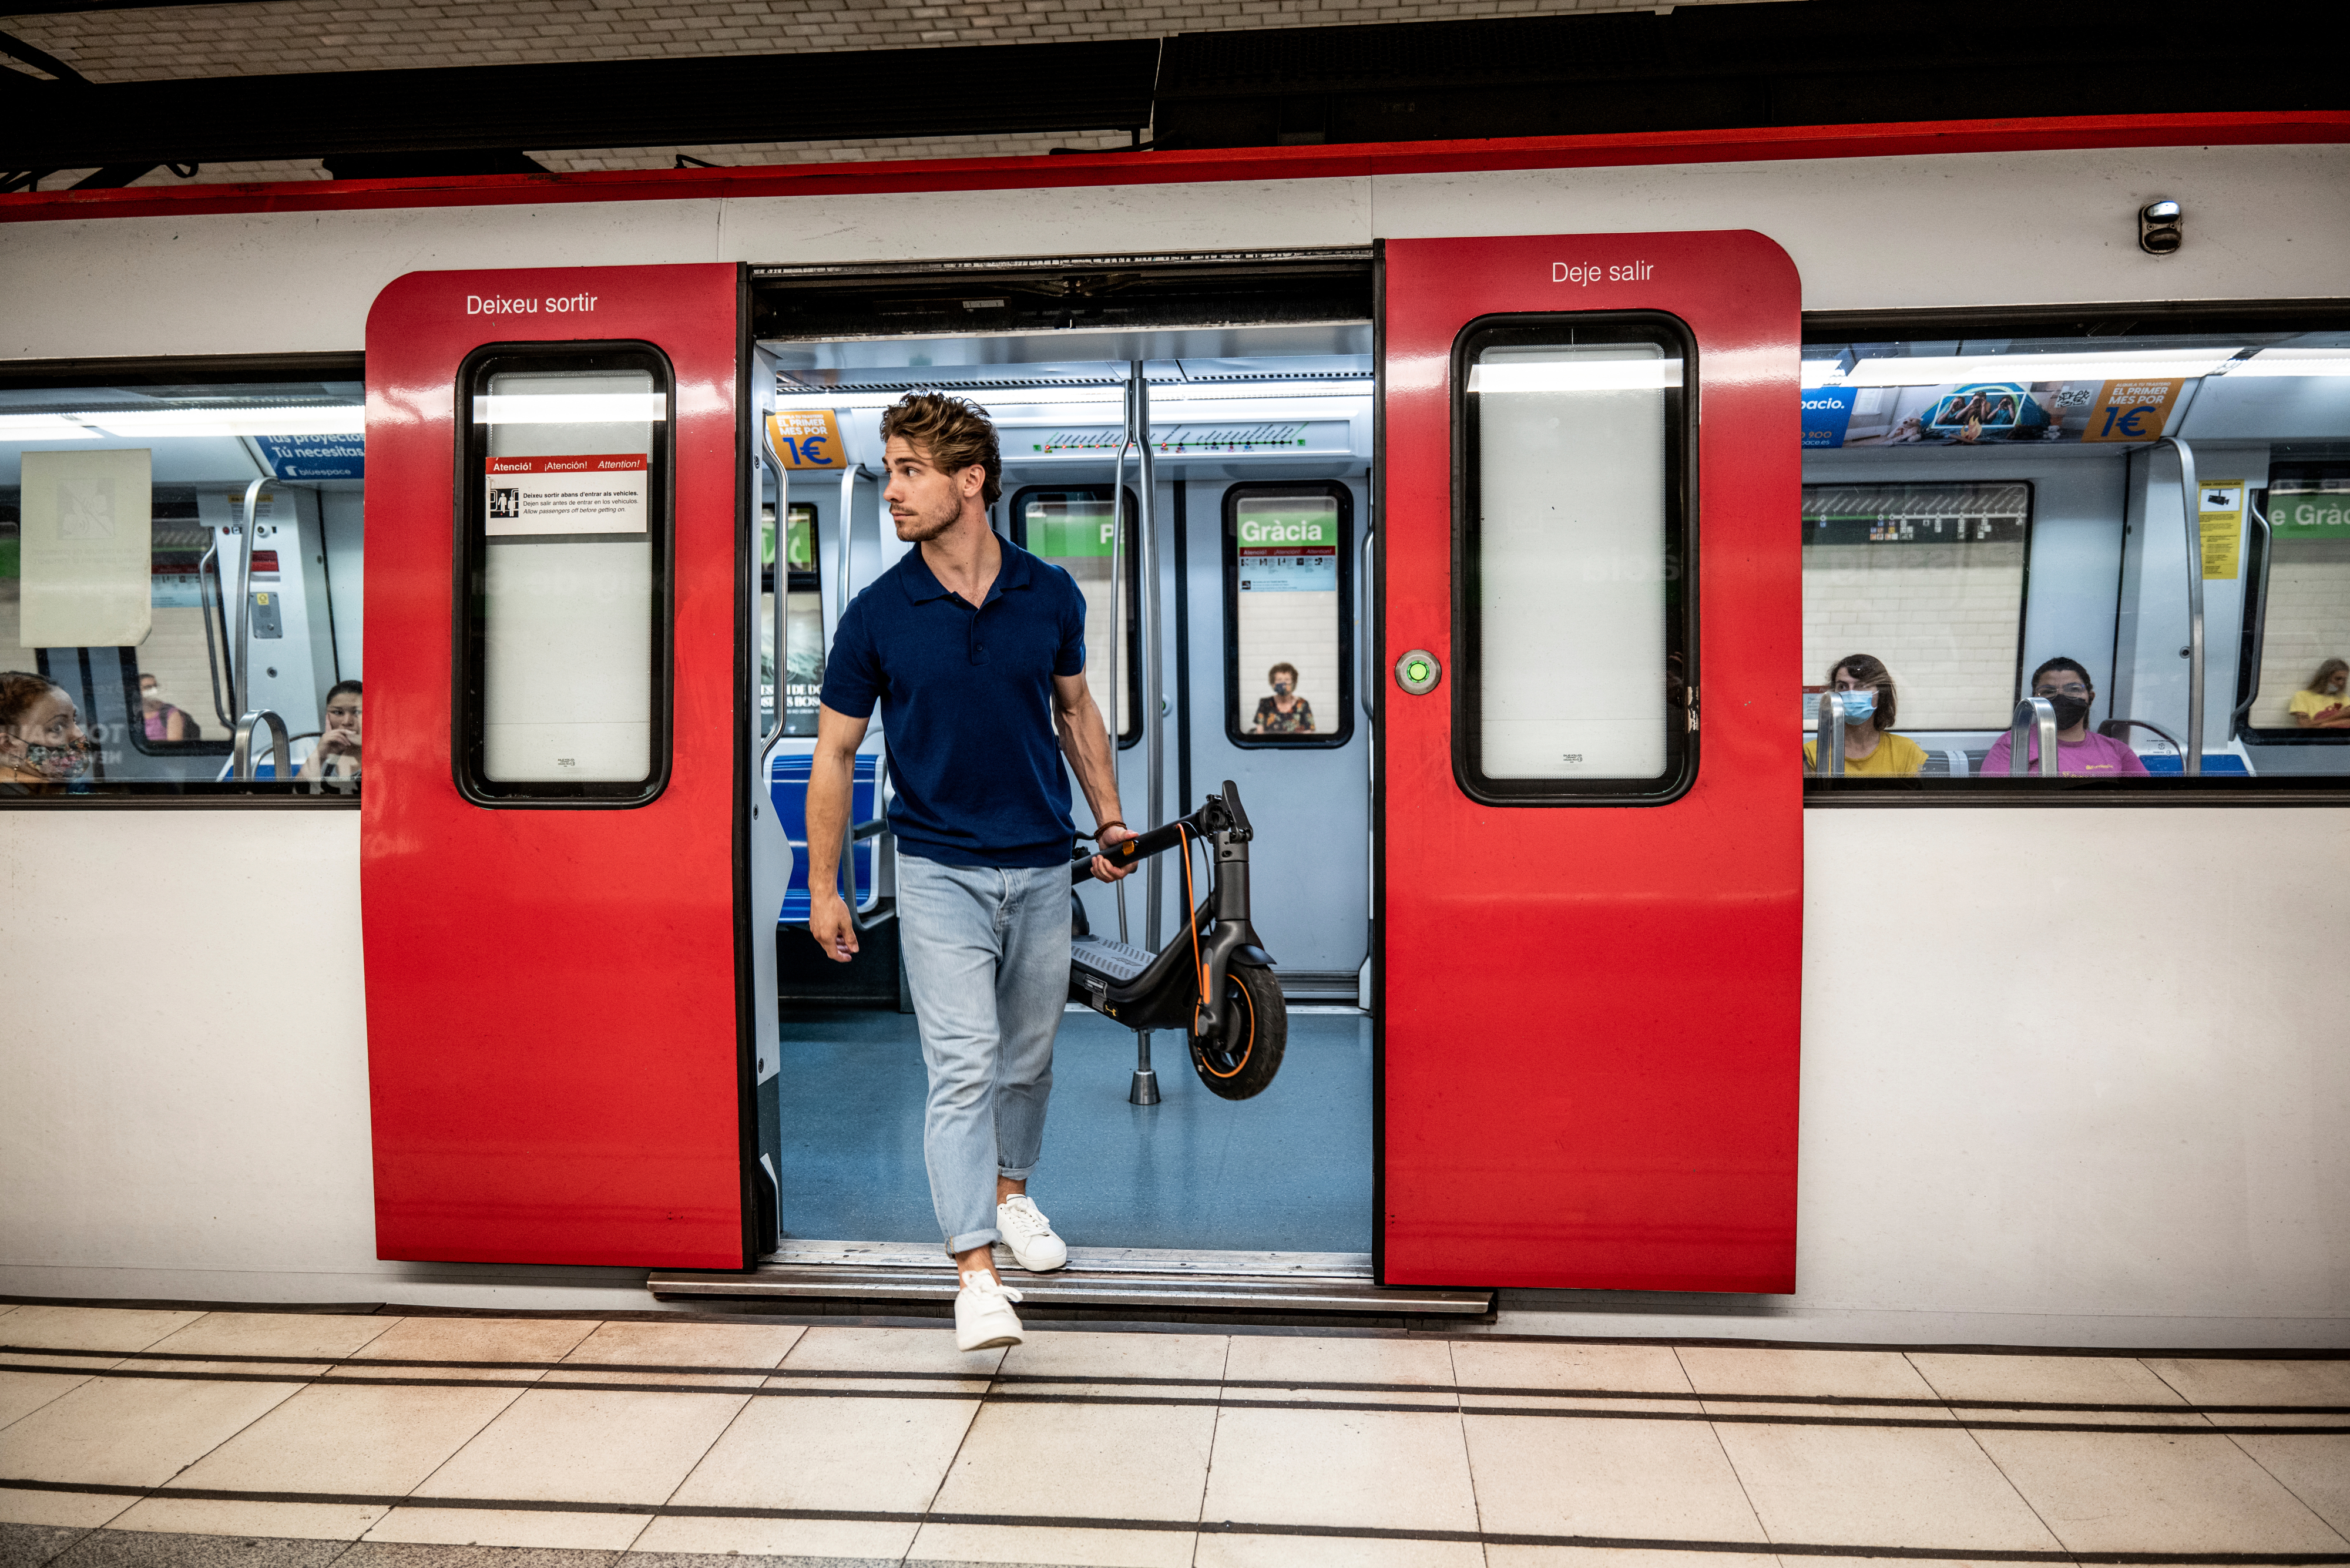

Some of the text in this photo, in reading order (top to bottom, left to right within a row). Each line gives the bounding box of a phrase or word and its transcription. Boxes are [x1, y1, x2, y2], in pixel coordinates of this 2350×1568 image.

[1552, 260, 1654, 287] Deje salir
[467, 292, 598, 315] Deixeu sortir
[2112, 387, 2168, 395] EL PRIMER
[2108, 395, 2165, 405] MES POR
[776, 418, 826, 427] EL PRIMER
[2100, 405, 2157, 437] 1€
[778, 426, 828, 435] MES POR
[271, 446, 293, 458] Tú
[782, 436, 833, 465] 1€
[493, 462, 532, 471] Atenció!
[544, 461, 588, 472] ¡Atención!
[597, 459, 640, 469] Attention!
[298, 468, 352, 476] bluespace
[1241, 519, 1322, 542] Gràcia
